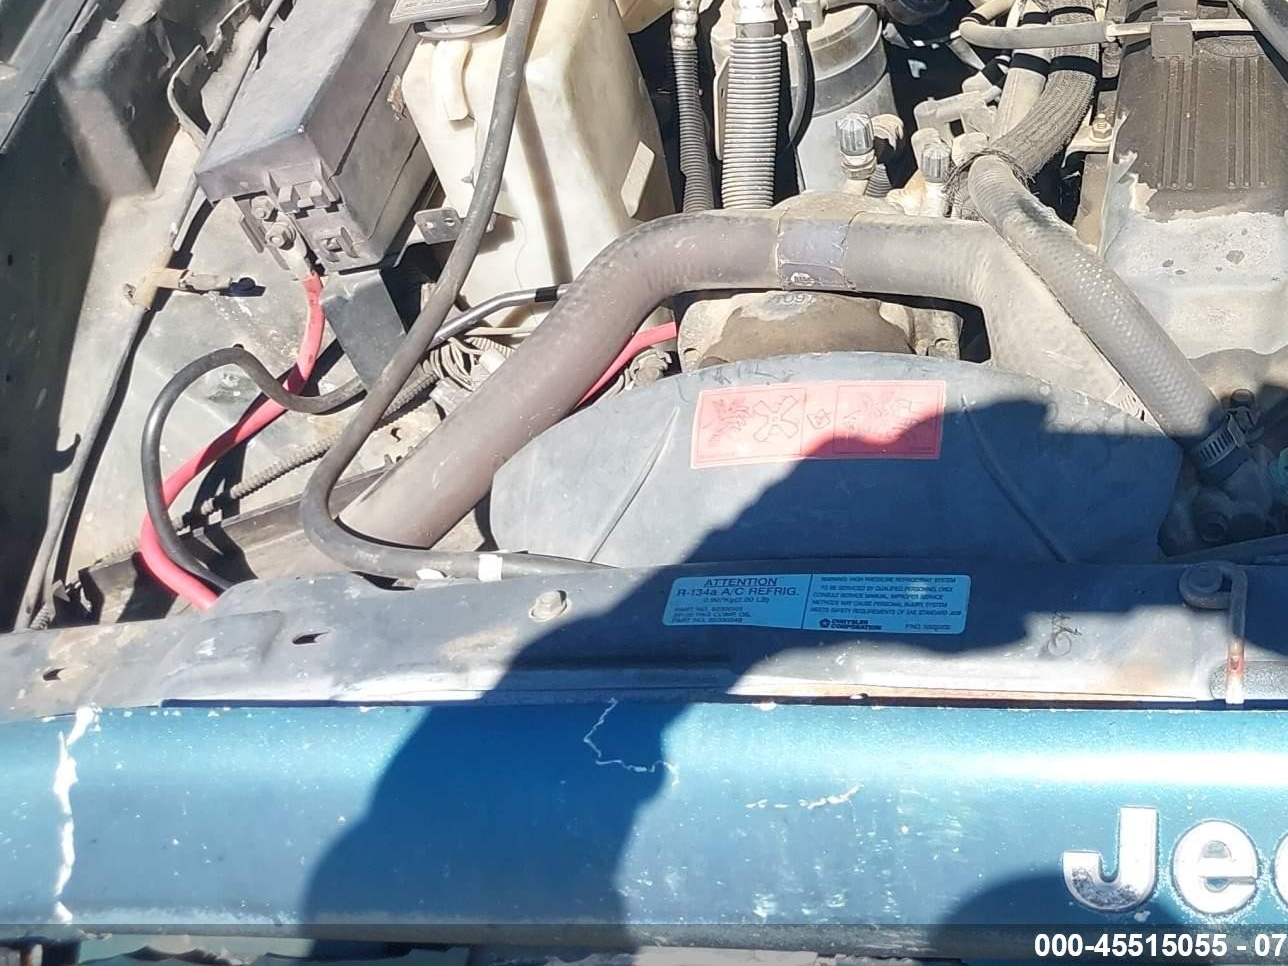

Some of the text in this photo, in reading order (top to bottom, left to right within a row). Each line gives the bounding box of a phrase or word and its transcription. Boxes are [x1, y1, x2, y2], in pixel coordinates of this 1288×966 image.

[703, 577, 779, 587] ATTENTION
[676, 586, 800, 597] R-134a A/C REFRIG.
